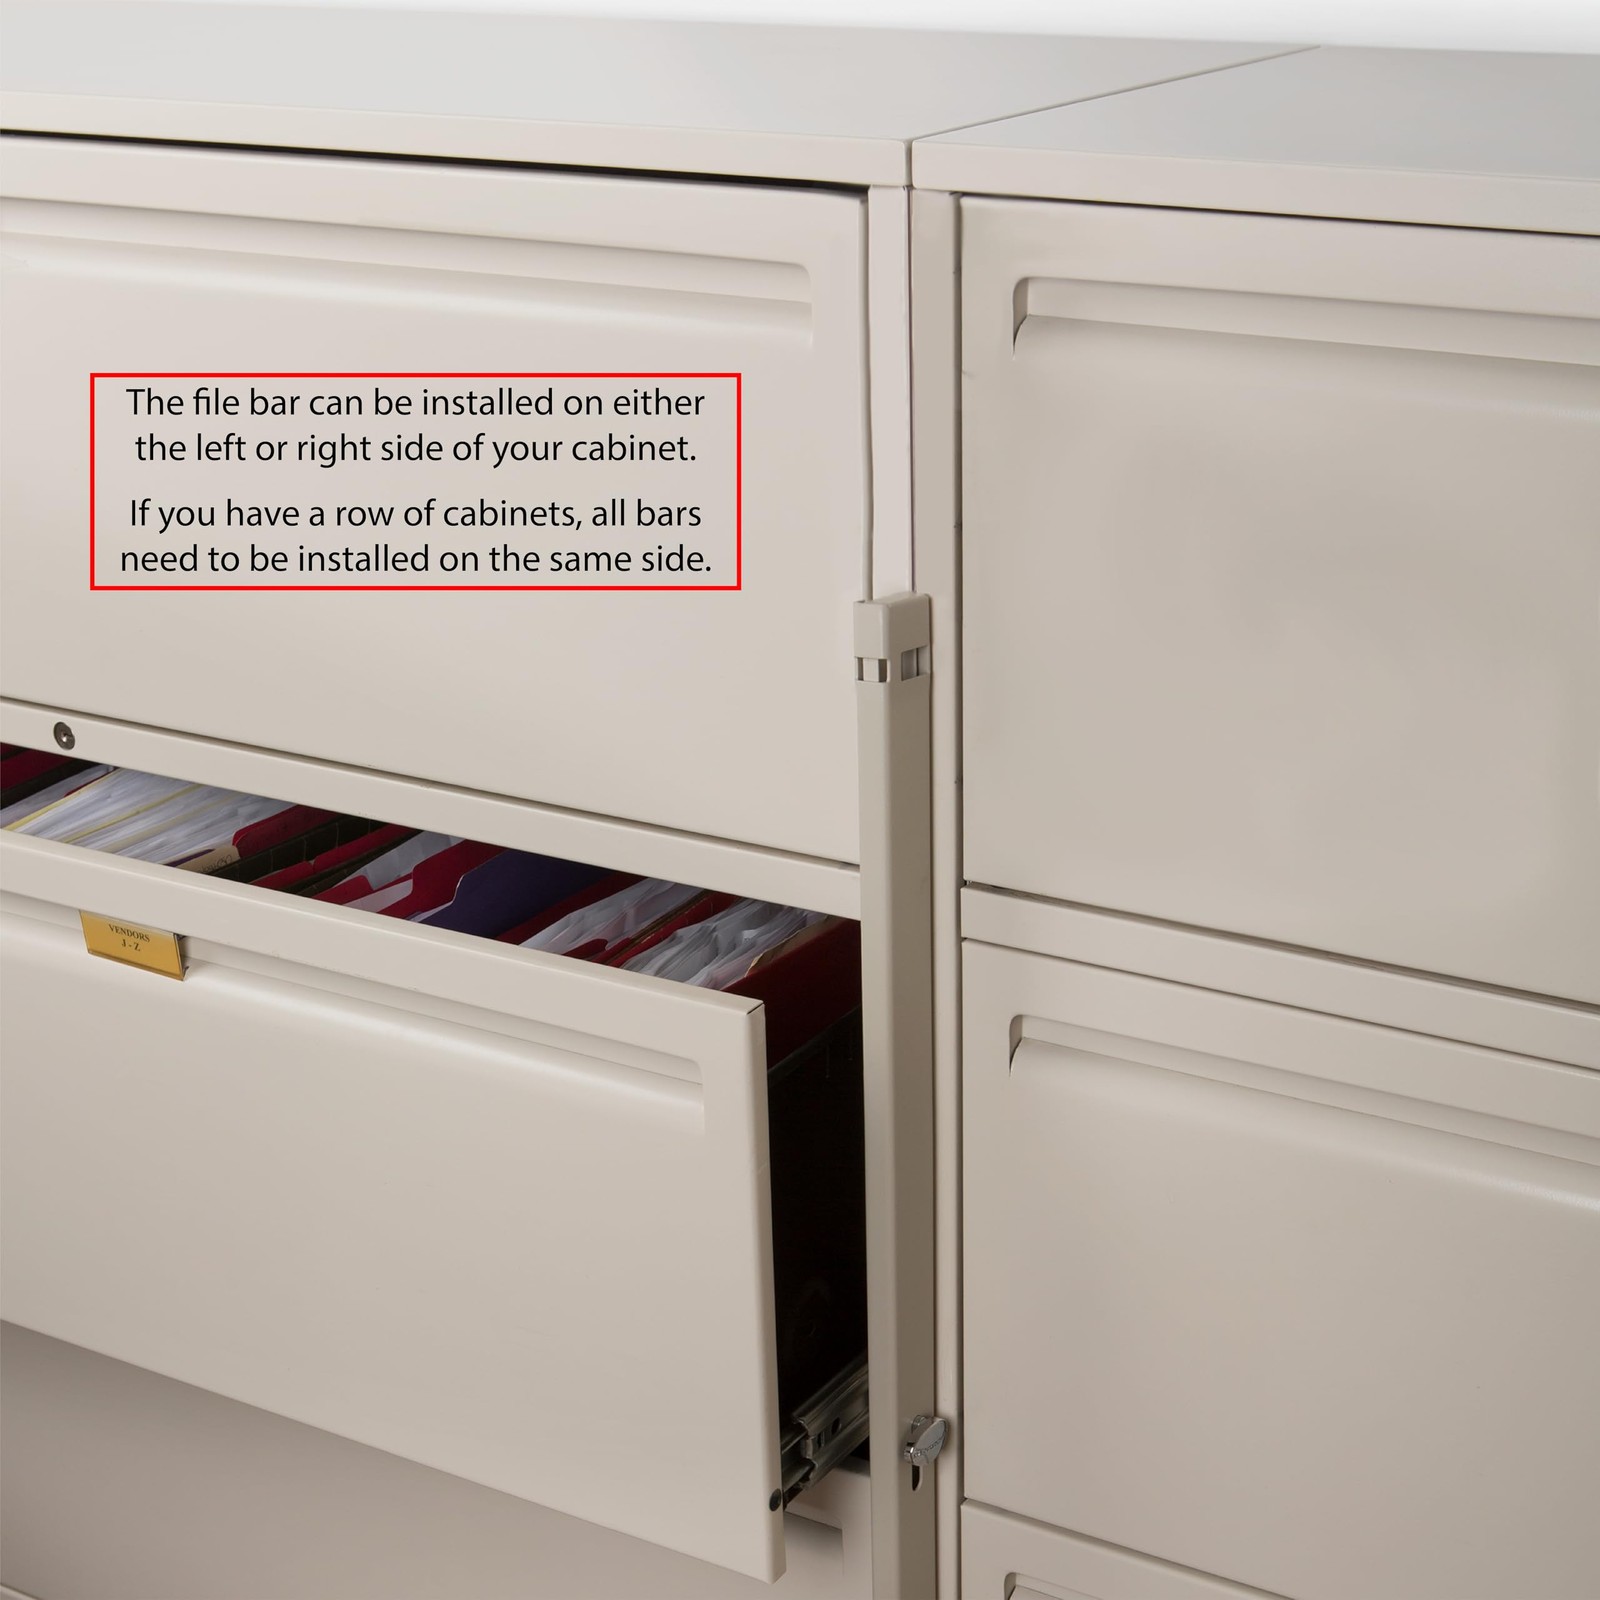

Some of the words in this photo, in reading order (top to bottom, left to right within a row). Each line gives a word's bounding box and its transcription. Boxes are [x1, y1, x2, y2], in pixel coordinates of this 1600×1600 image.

[108, 923, 151, 943] VENDORS
[121, 938, 127, 948] J
[134, 942, 141, 952] Z
